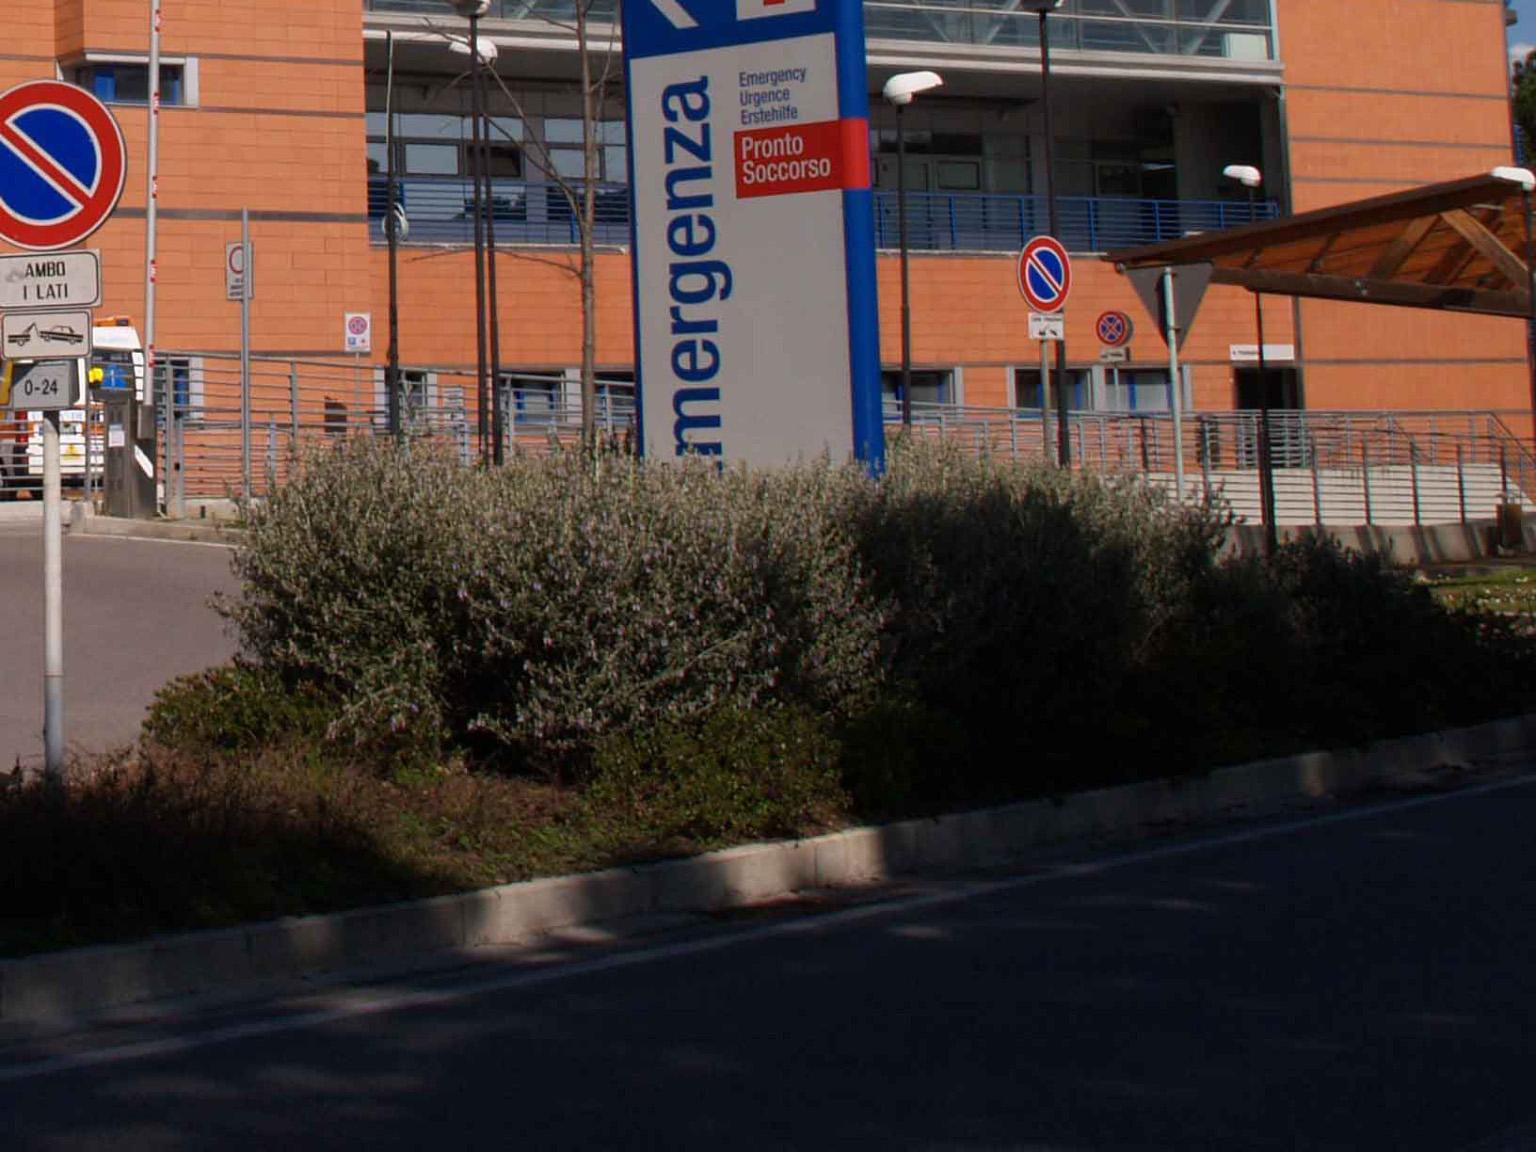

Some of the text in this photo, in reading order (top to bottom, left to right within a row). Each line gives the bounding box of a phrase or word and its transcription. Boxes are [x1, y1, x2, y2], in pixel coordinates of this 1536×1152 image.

[738, 67, 807, 87] Emergency
[739, 87, 791, 107] Urgence
[740, 104, 799, 125] Erstehilfe
[741, 132, 804, 161] Pronto
[742, 157, 831, 185] Soccorso
[24, 261, 66, 278] AMBO
[661, 75, 733, 478] mergenza
[23, 283, 69, 300] I LATI
[23, 378, 59, 396] 0-24
